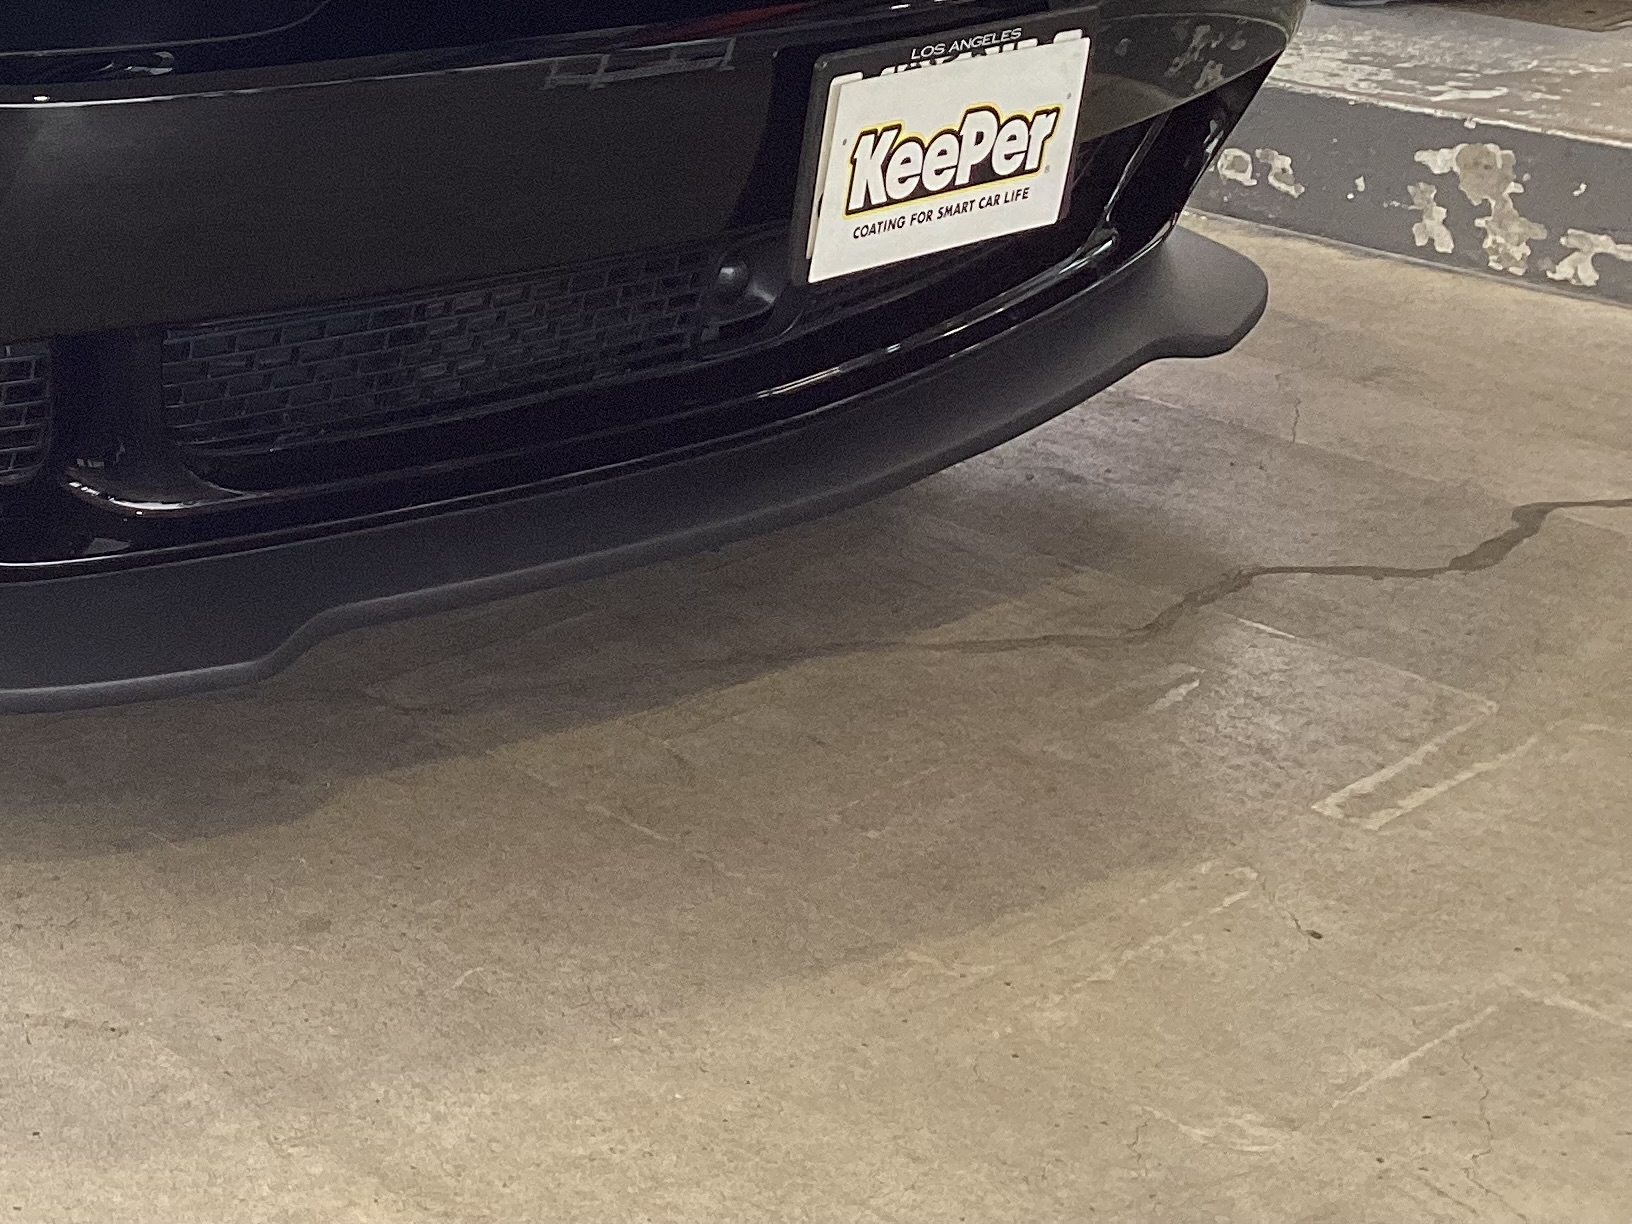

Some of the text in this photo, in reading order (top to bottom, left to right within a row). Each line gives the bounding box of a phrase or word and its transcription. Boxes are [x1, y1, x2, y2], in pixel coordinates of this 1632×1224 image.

[911, 27, 1023, 60] LOS ANGELES
[845, 104, 1061, 216] KeePer
[853, 187, 1030, 239] COATING FOR SMART CAR LIFE
